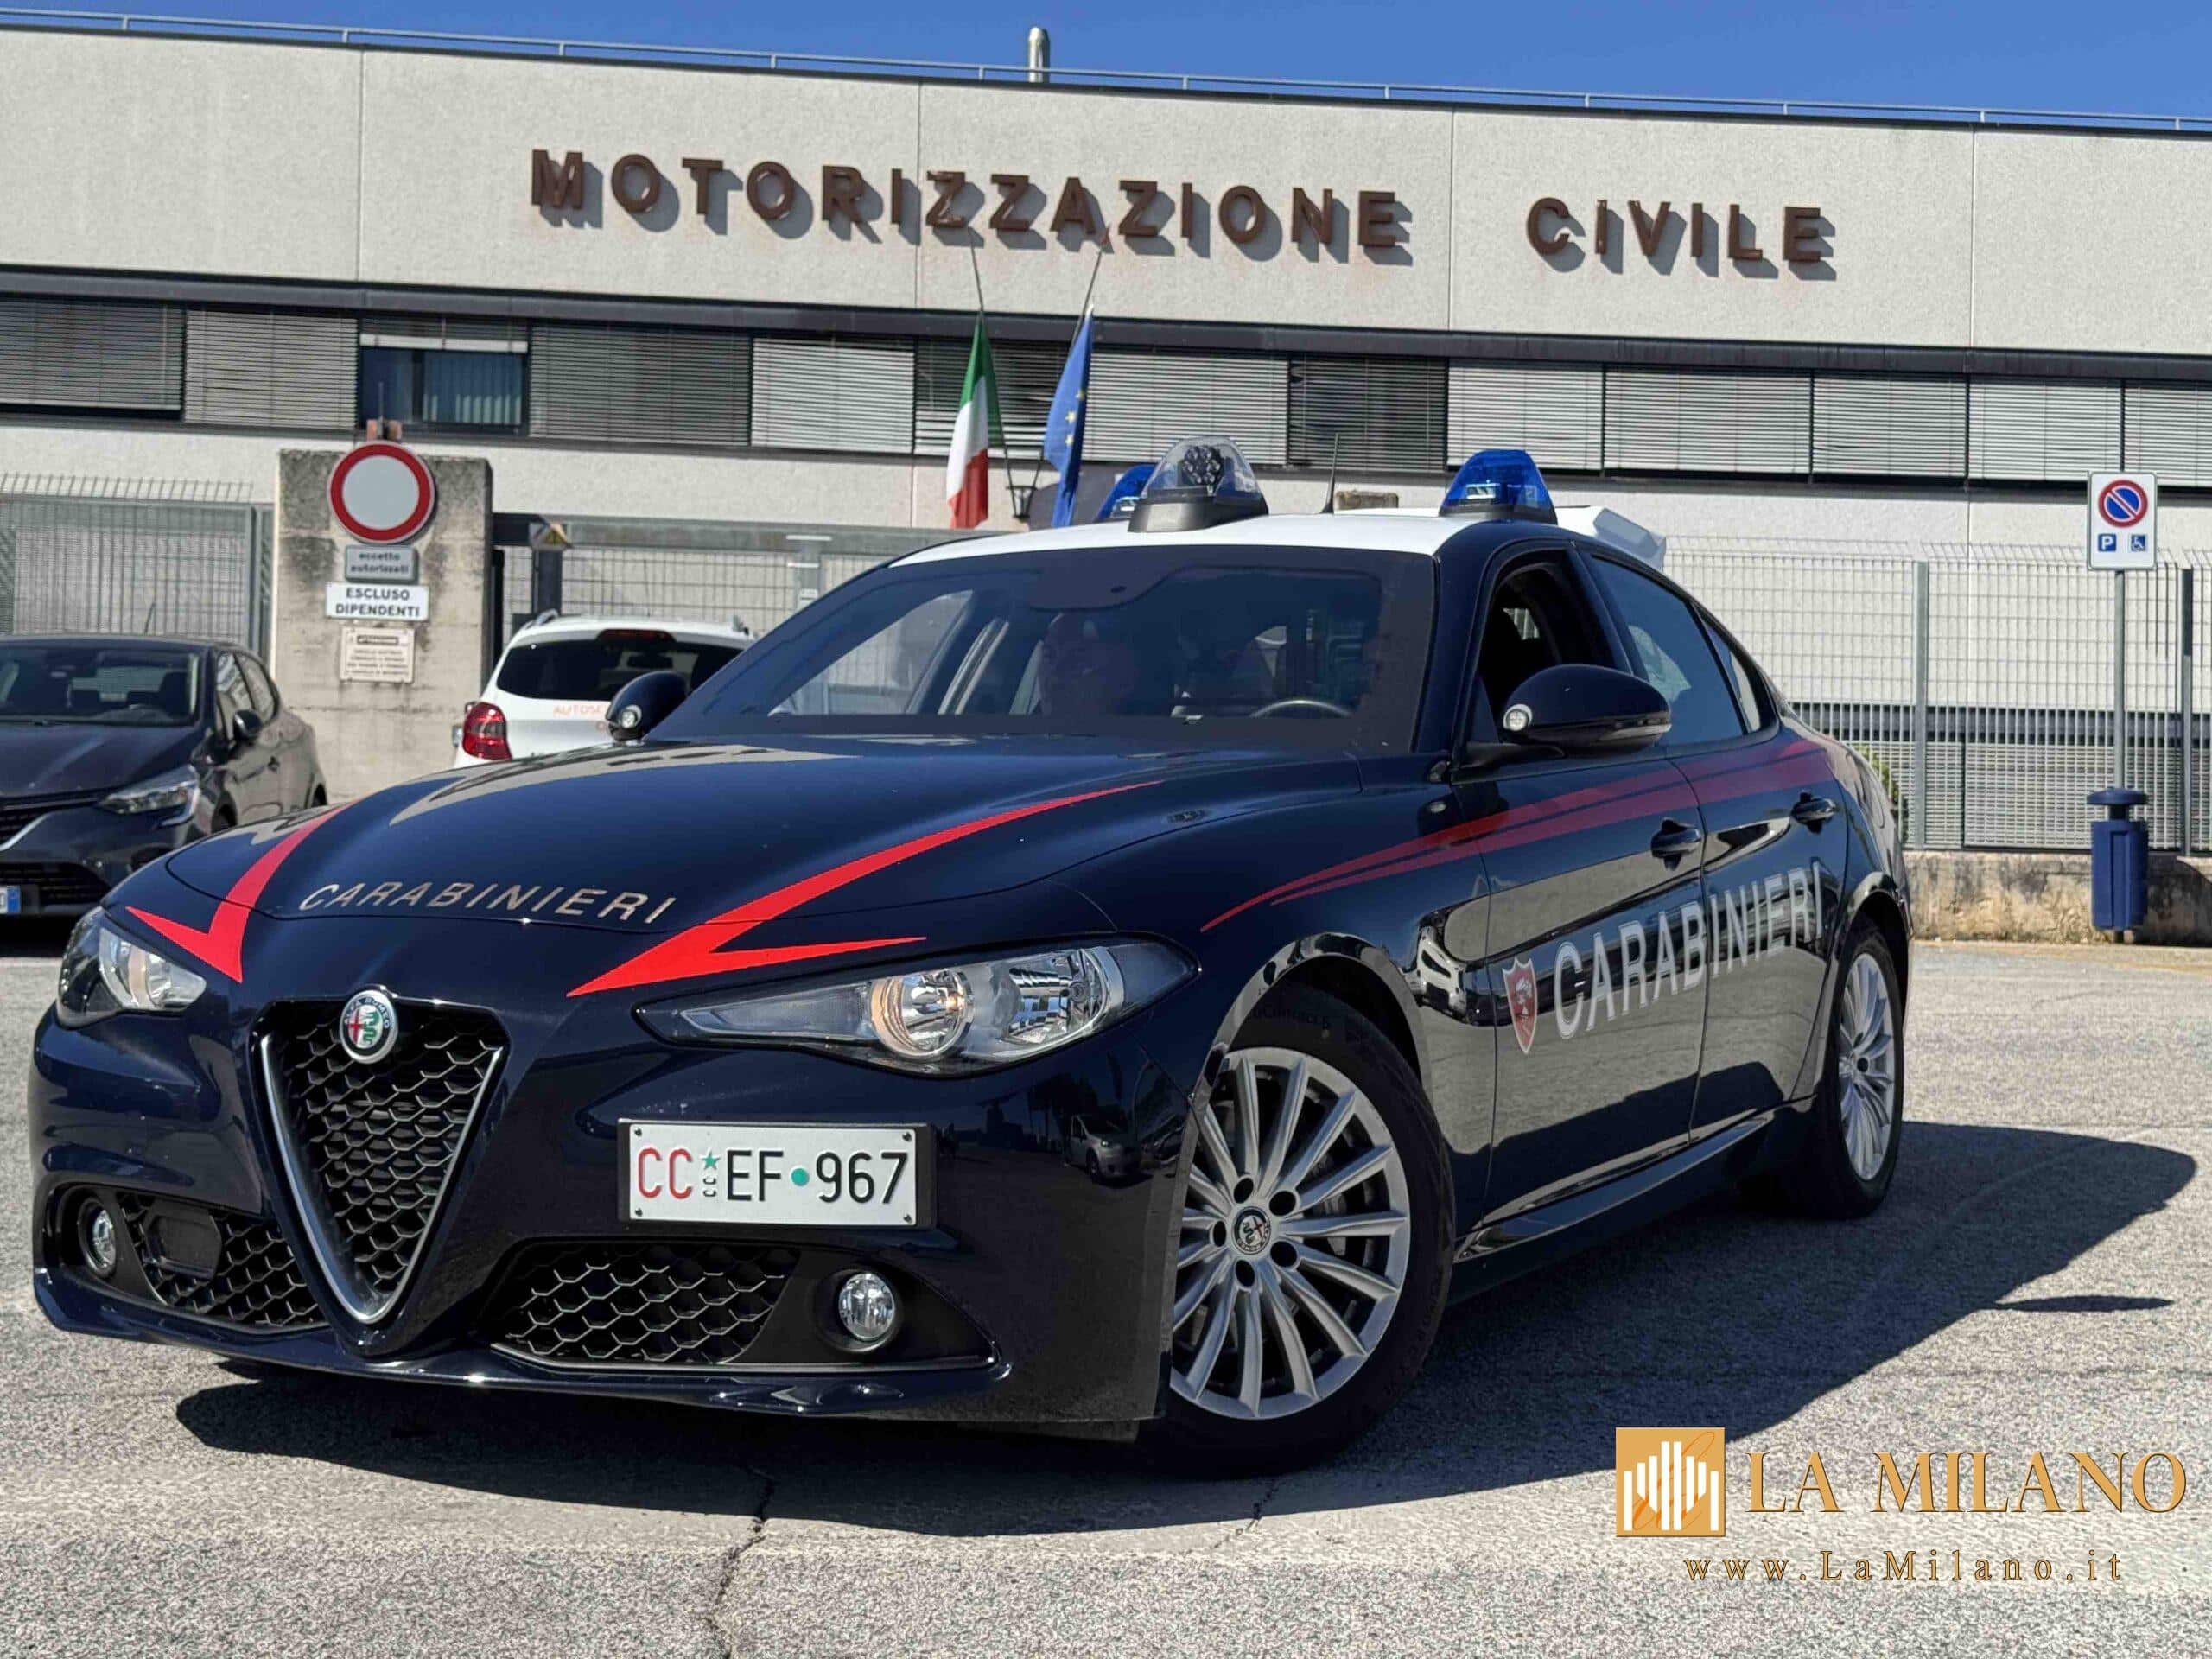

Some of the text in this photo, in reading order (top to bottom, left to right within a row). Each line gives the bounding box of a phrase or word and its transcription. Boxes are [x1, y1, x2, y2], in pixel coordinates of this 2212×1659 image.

[531, 149, 1822, 263] MOTORIZZAZIONE CIVILE
[335, 603, 420, 617] DIPENDENTI
[346, 588, 410, 601] ESCLUSO
[298, 880, 677, 924] CARABINIERI
[1555, 861, 1822, 1039] CARABINIERI
[638, 1147, 693, 1200] CC
[727, 1149, 785, 1202] EF
[815, 1151, 909, 1205] 967
